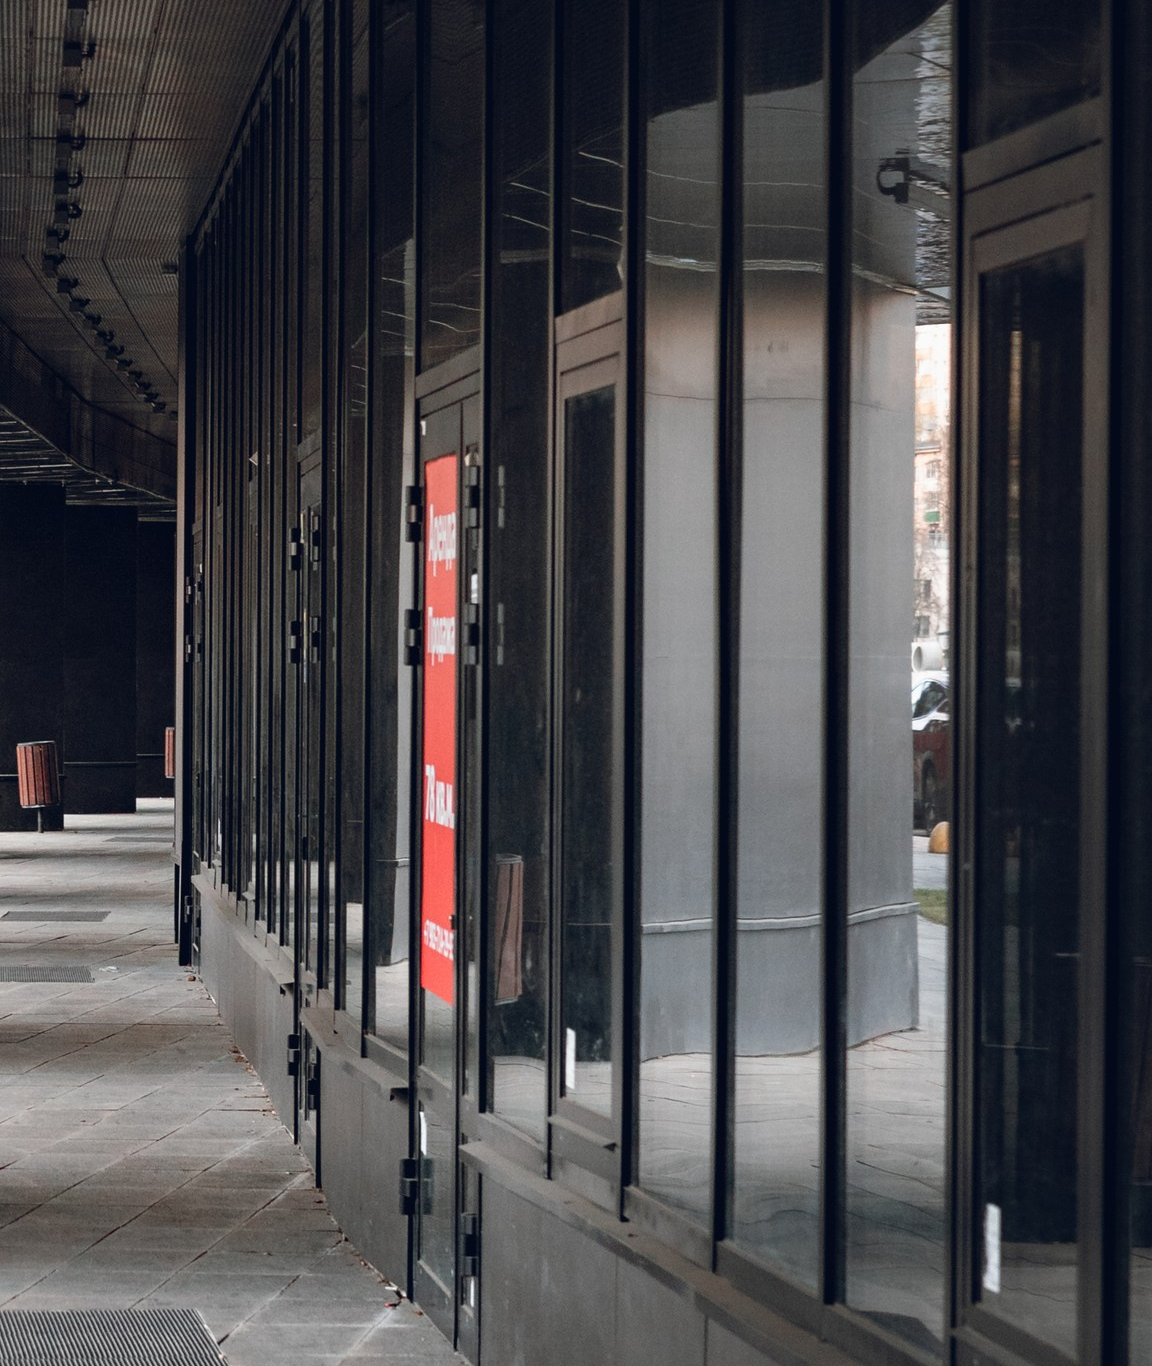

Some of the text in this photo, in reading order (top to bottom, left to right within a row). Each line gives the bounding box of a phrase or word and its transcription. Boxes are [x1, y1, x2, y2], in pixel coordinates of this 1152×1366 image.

[428, 503, 456, 576] Аренда
[427, 606, 456, 666] Продажа
[425, 764, 436, 822] 78
